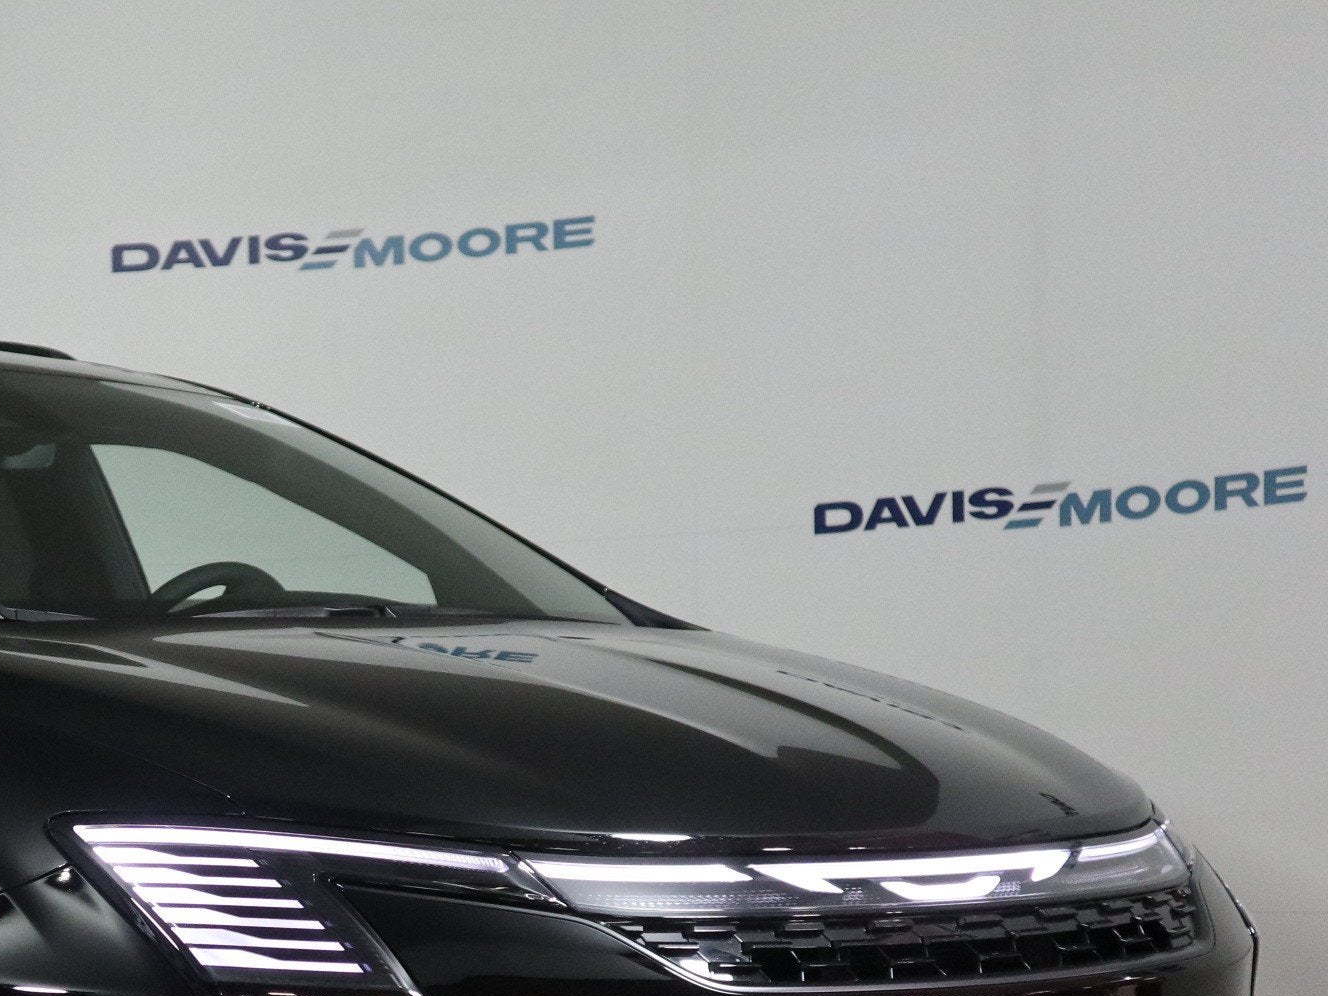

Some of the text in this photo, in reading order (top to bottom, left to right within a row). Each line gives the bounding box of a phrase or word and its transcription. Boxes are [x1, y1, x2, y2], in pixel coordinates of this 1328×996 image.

[111, 214, 597, 274] DAVIS MOORE
[813, 464, 1309, 535] DAVIS MOORE
